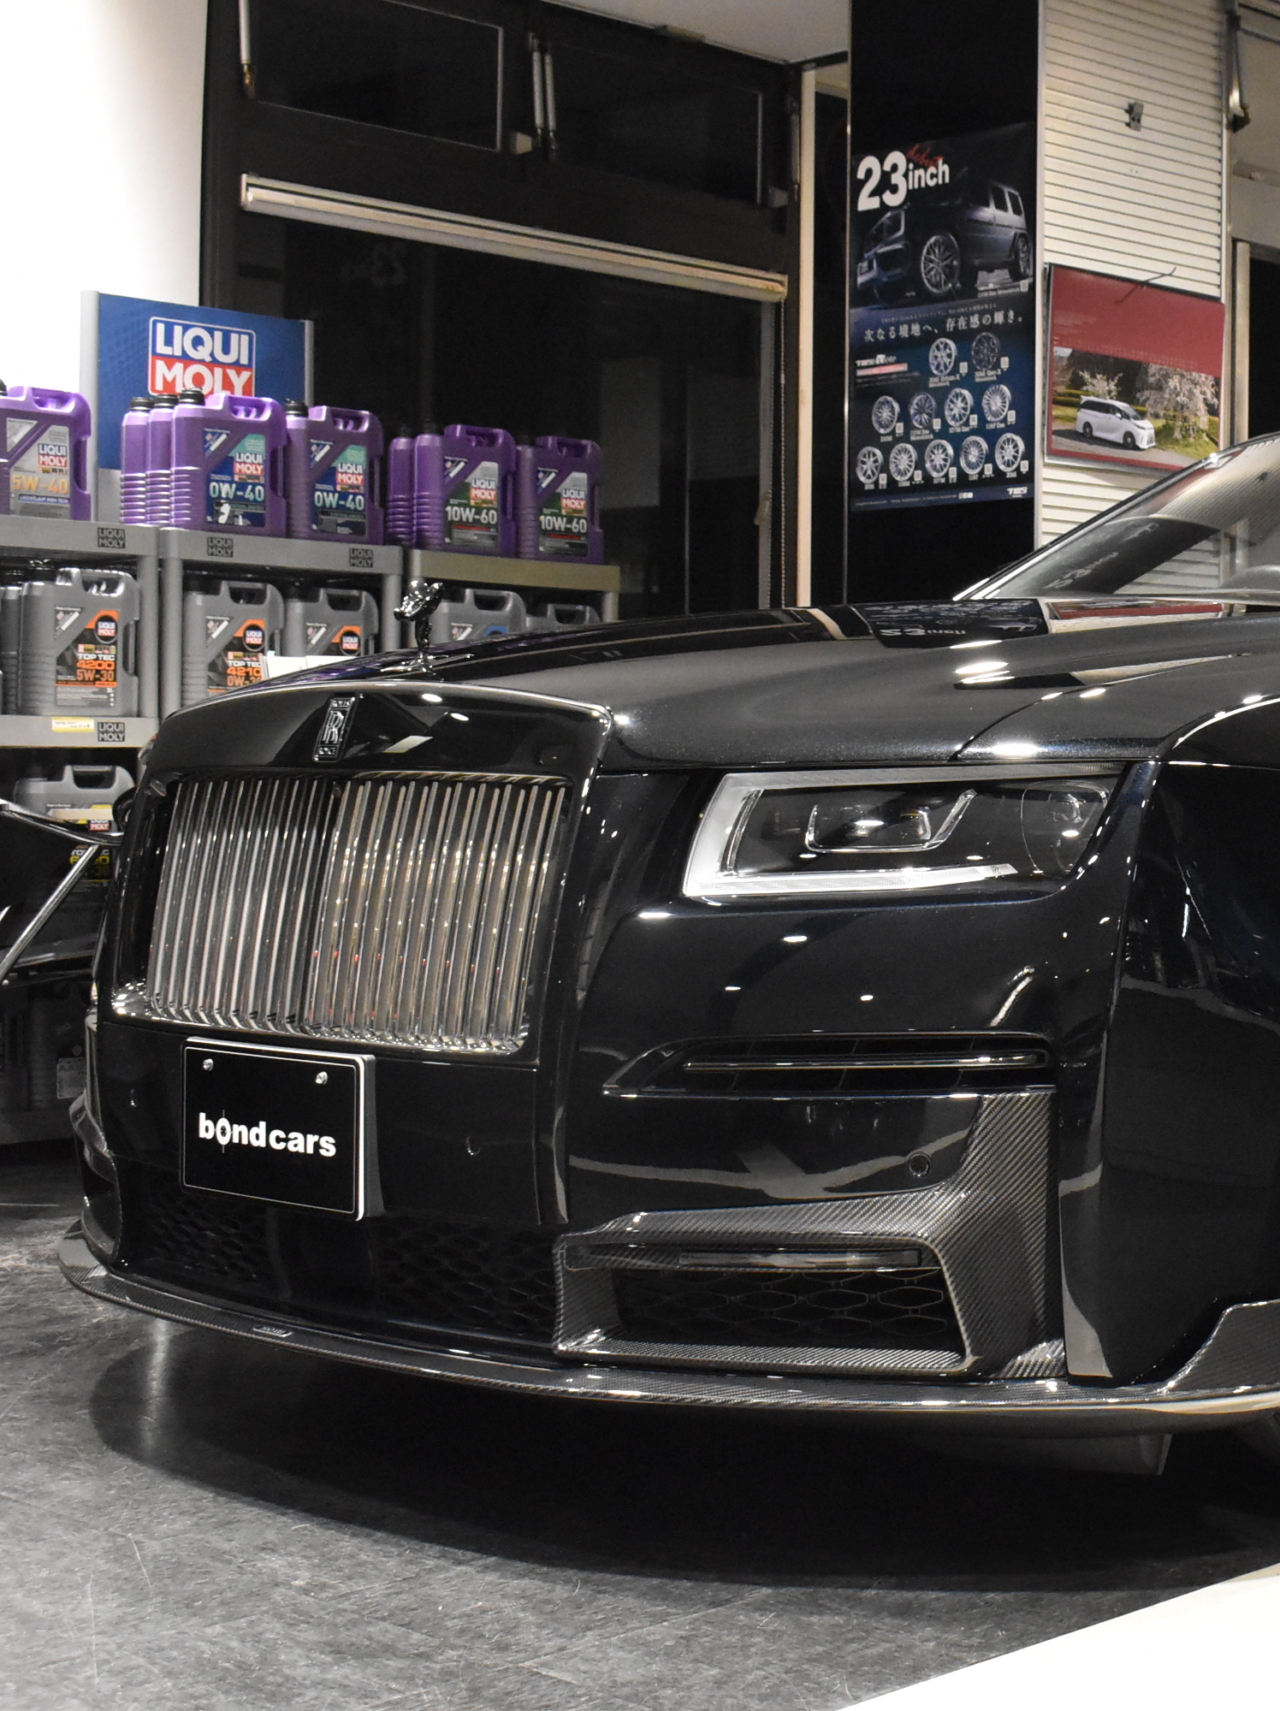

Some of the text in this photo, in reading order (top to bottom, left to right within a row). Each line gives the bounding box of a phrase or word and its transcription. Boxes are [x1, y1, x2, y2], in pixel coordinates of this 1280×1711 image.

[155, 322, 249, 365] LIQUI
[154, 360, 252, 396] MOLY
[39, 444, 66, 456] LIQUI
[39, 455, 67, 466] MOLY
[235, 452, 263, 464] LIQUI
[235, 463, 264, 474] MOLY
[337, 463, 363, 474] LIQUI
[11, 474, 69, 494] 5W-40
[338, 473, 364, 484] MOLY
[471, 479, 496, 490] LIQUI
[209, 481, 265, 501] 0W-40
[471, 489, 497, 500] MOLY
[562, 489, 585, 499] LIQUI
[314, 491, 365, 511] 0W-40
[562, 498, 586, 509] MOLY
[445, 505, 498, 525] 10W-60
[539, 514, 587, 533] 10W-60
[98, 527, 125, 538] LIQUI
[98, 538, 125, 548] MOLY
[207, 537, 233, 547] LIQUI
[207, 547, 233, 557] MOLY
[76, 660, 115, 670] 4200
[76, 669, 114, 681] 5W-30
[226, 667, 262, 677] 4210
[98, 722, 125, 732] LIQUI
[98, 732, 125, 741] MOLY
